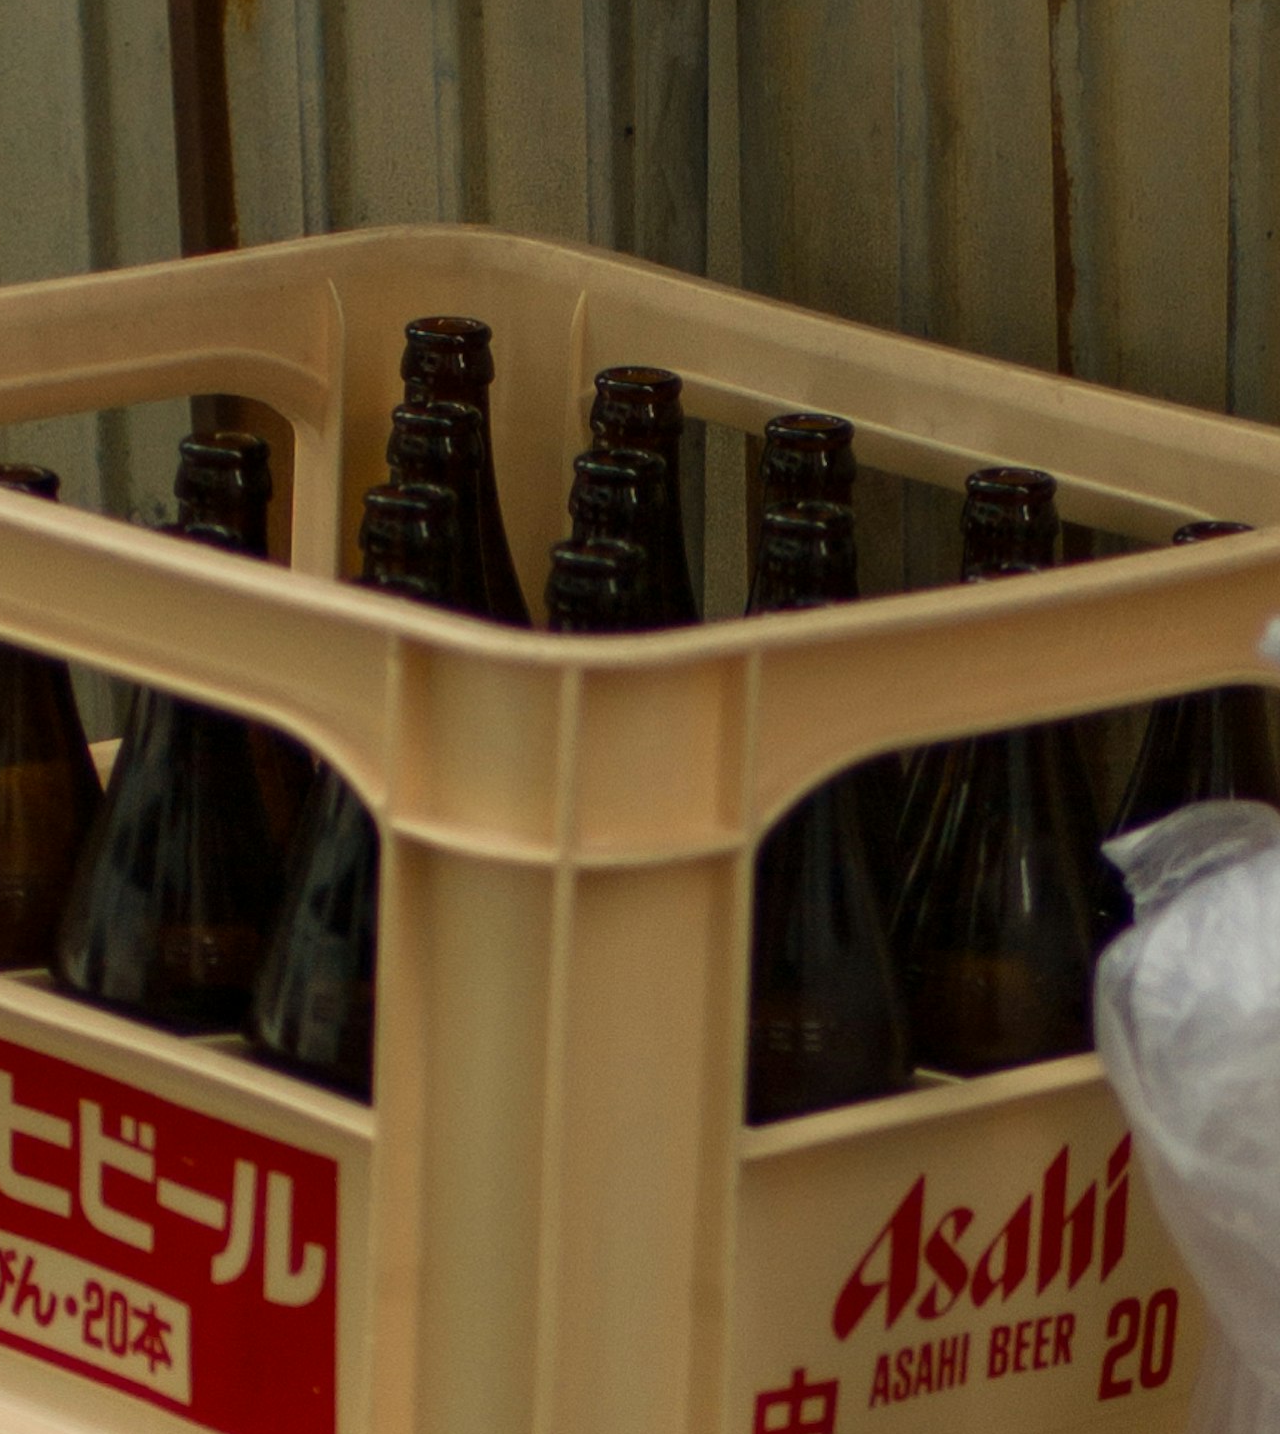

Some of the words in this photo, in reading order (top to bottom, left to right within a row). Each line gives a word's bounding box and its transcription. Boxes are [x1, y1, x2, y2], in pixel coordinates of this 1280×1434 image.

[832, 1130, 1132, 1342] Asahi
[868, 1332, 971, 1410] ASAHI
[987, 1313, 1076, 1379] BEER
[1098, 1287, 1179, 1402] 20
